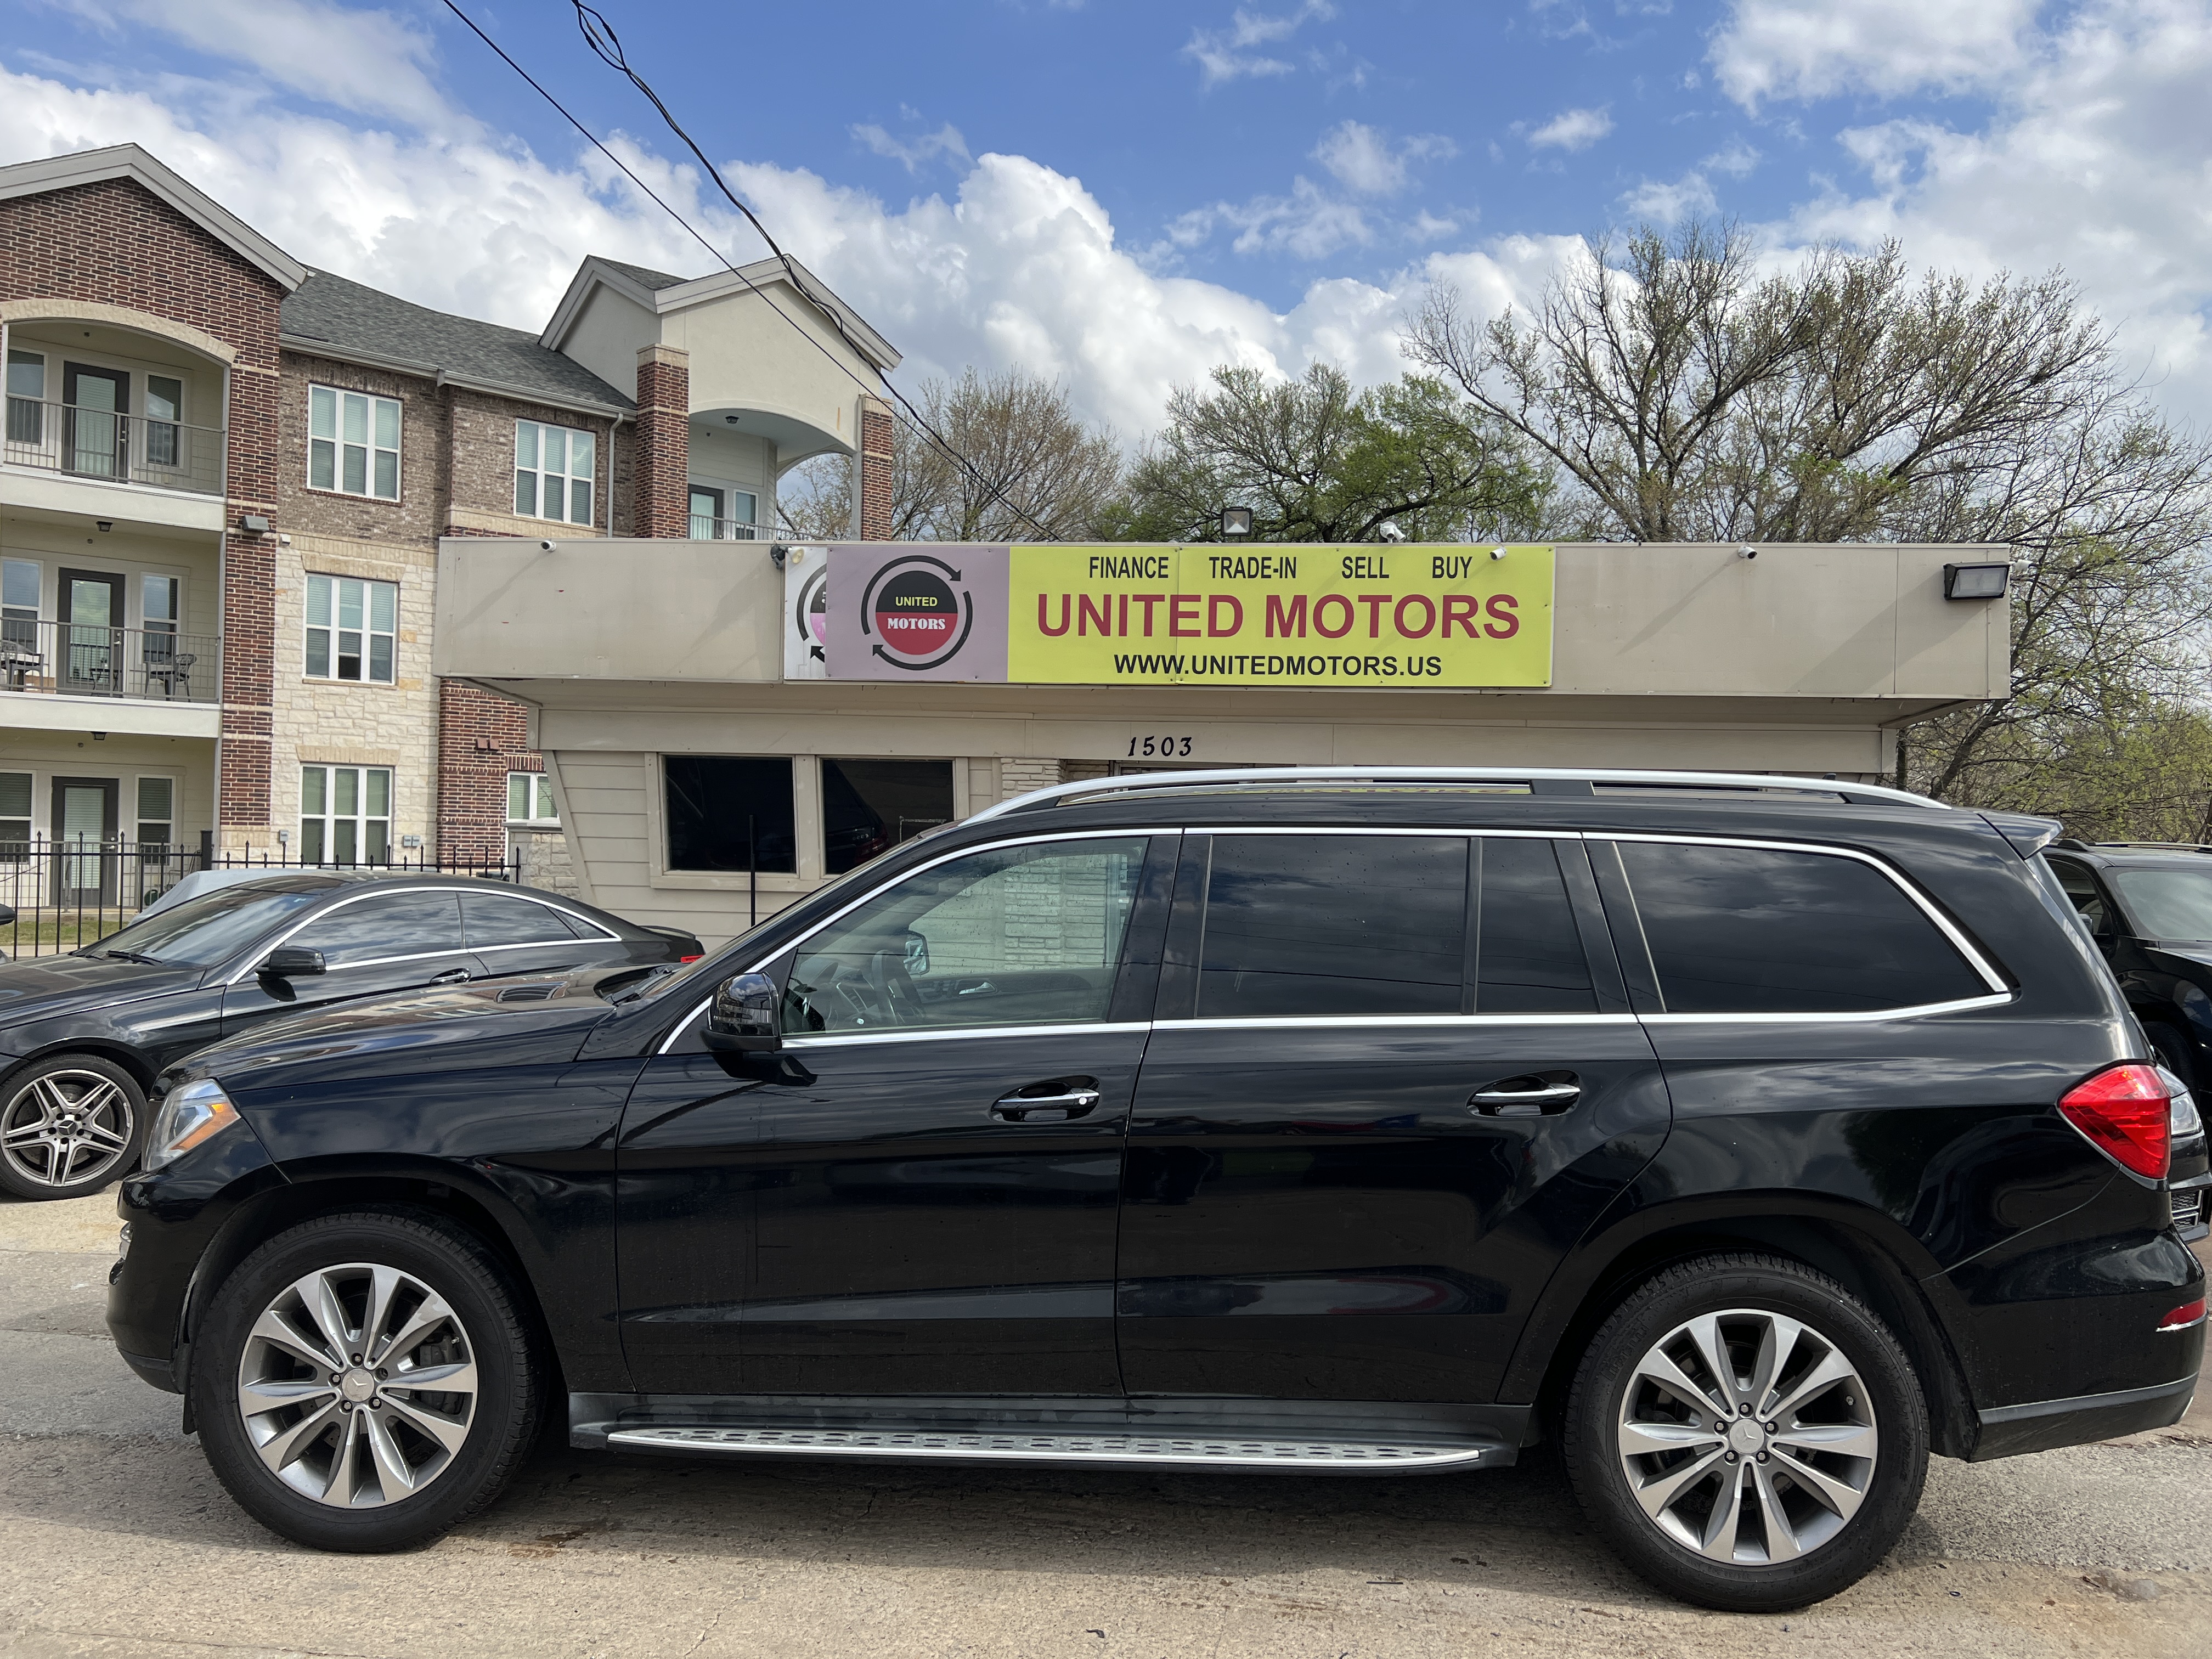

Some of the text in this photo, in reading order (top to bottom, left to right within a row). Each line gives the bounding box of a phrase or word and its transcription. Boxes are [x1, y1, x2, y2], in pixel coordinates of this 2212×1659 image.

[1089, 556, 1472, 579] FINANCE TRADE-IN SELL BUY
[895, 596, 938, 606] UNITED
[888, 618, 945, 630] MOTORS
[1039, 594, 1519, 639] UNITED MOTORS
[1114, 654, 1441, 676] WWW.UNITEDMOTORS.US
[1127, 735, 1192, 757] 1503
